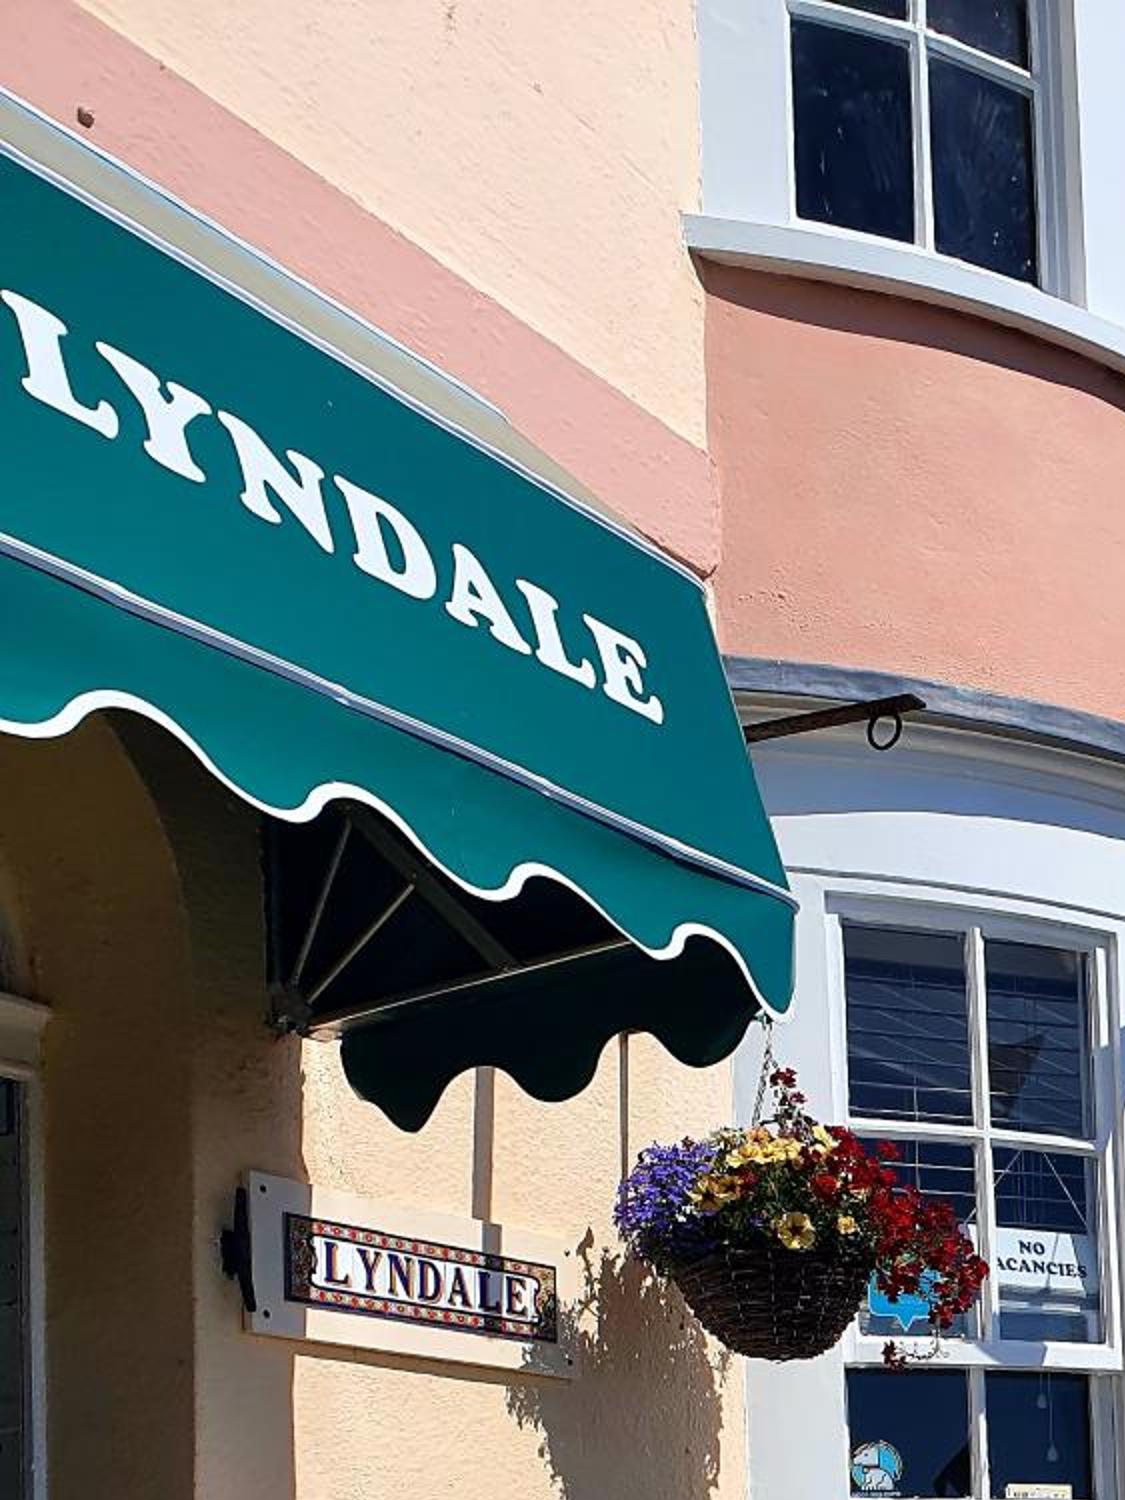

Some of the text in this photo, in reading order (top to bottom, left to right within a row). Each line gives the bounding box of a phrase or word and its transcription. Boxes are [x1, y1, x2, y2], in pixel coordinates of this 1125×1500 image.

[1, 289, 663, 725] LYNDALE
[997, 1257, 1087, 1279] ACANCIES
[1018, 1240, 1046, 1256] NO
[323, 1241, 528, 1316] LYNDALE
